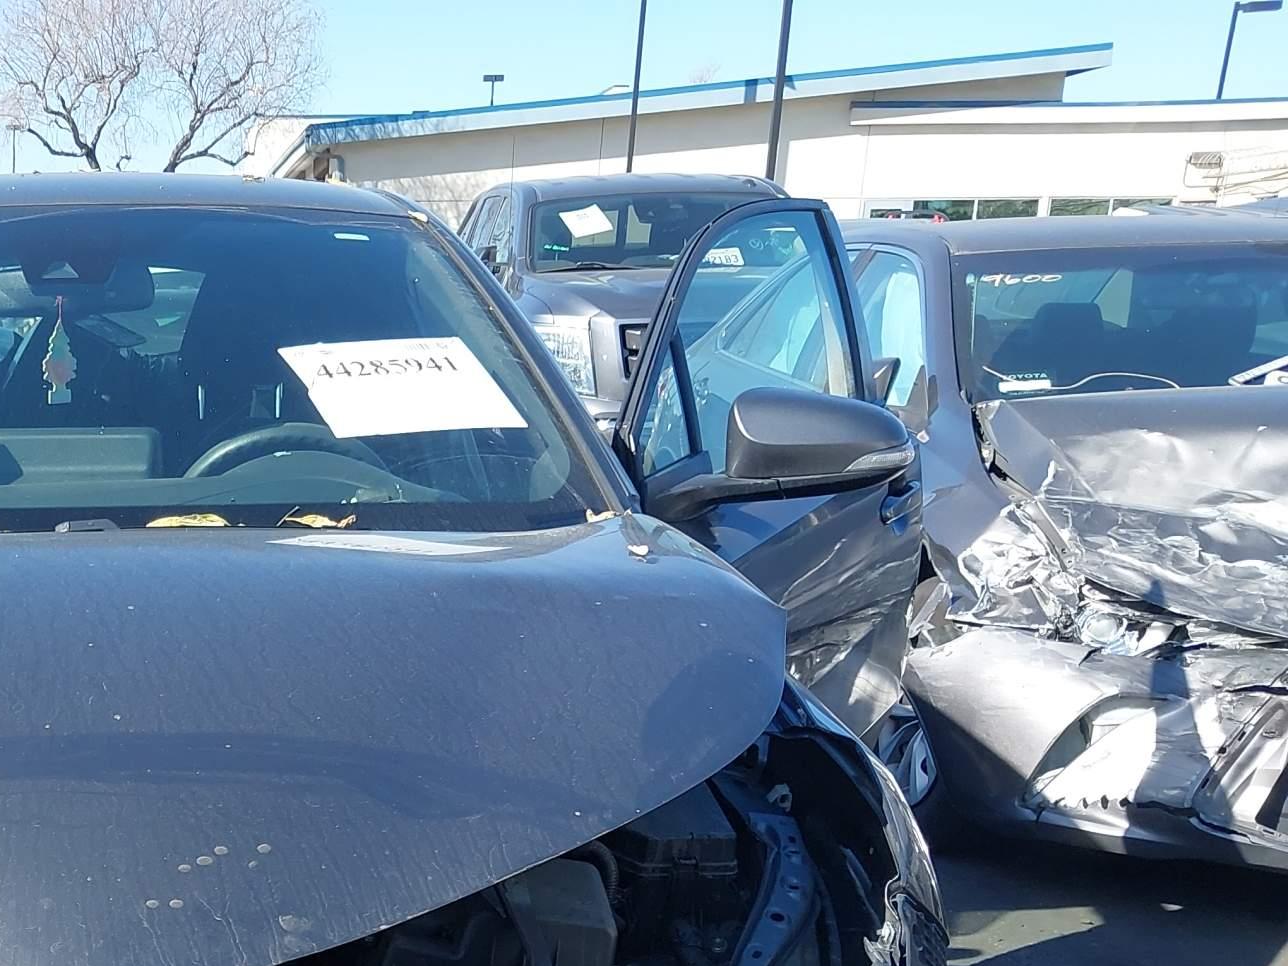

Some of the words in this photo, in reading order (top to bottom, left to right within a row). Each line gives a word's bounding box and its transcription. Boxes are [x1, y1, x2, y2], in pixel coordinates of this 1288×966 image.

[980, 273, 1063, 287] 9600
[317, 356, 458, 379] 44285941
[1005, 372, 1049, 380] OYOTA
